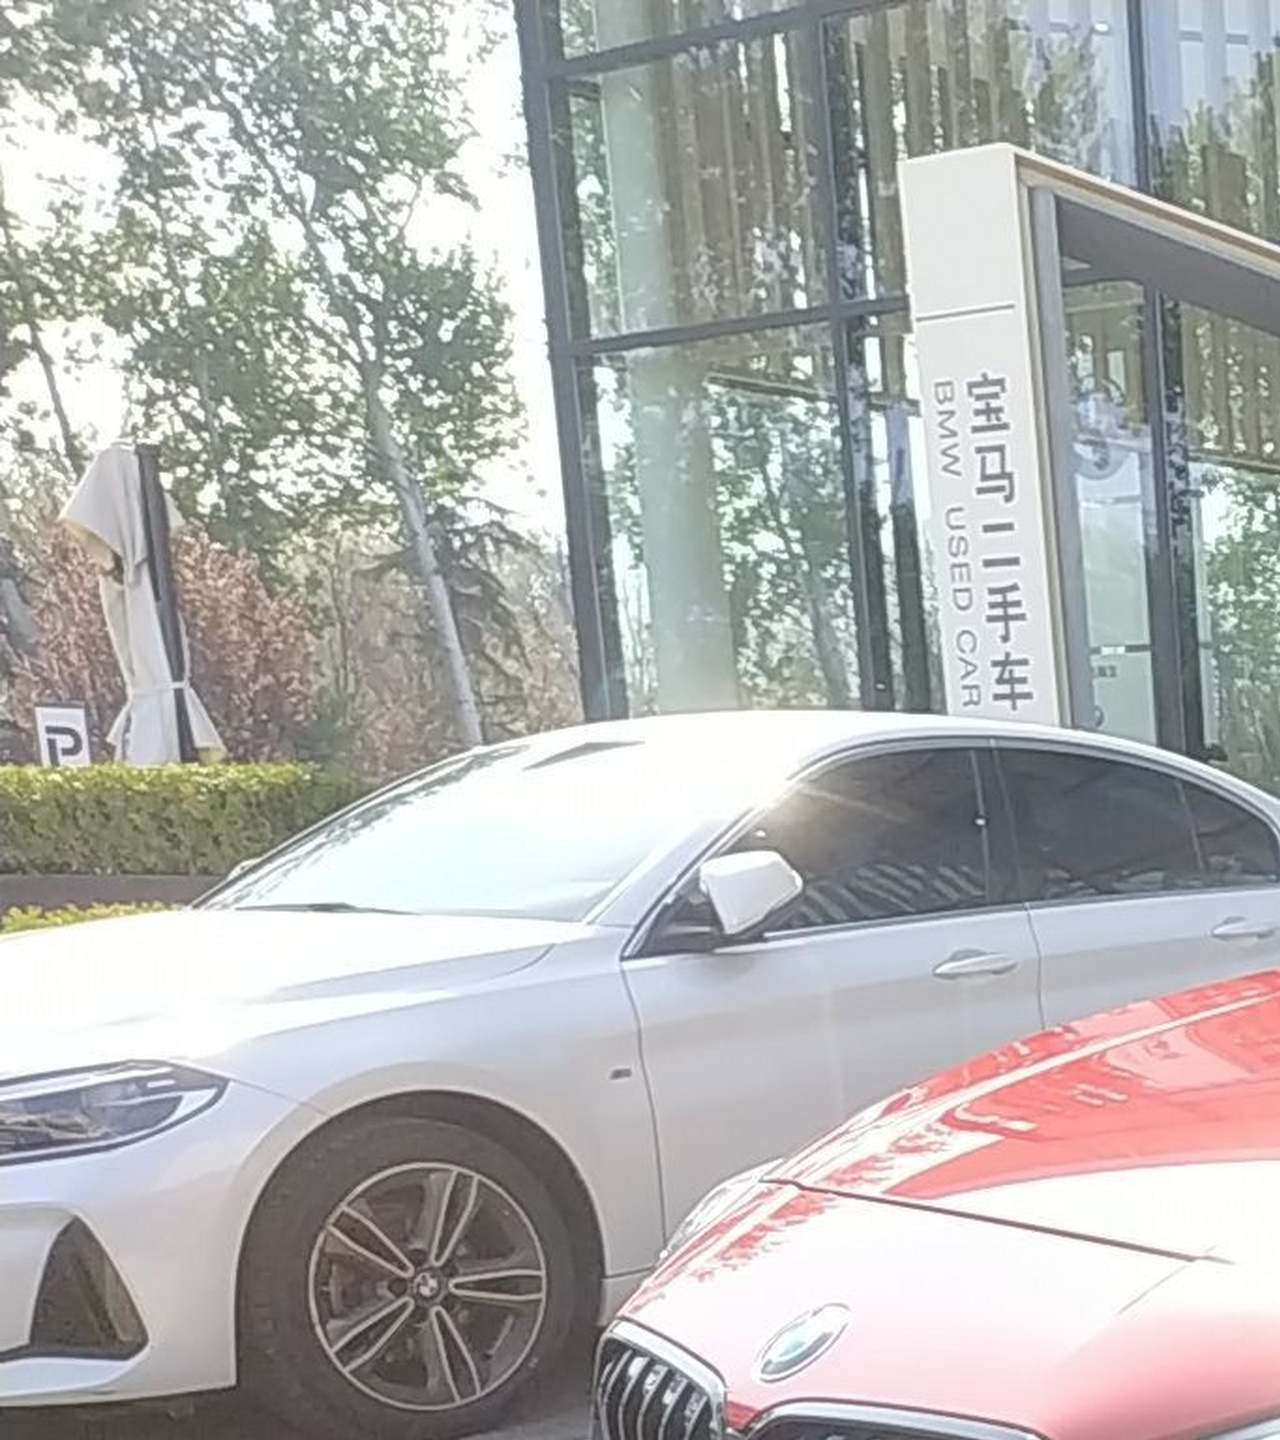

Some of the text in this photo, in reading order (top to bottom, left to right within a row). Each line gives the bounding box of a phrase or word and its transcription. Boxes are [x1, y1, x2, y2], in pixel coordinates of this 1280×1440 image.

[934, 380, 981, 707] BMW USED CAR
[967, 372, 1033, 711] 宝马二手车
[45, 726, 83, 767] P
